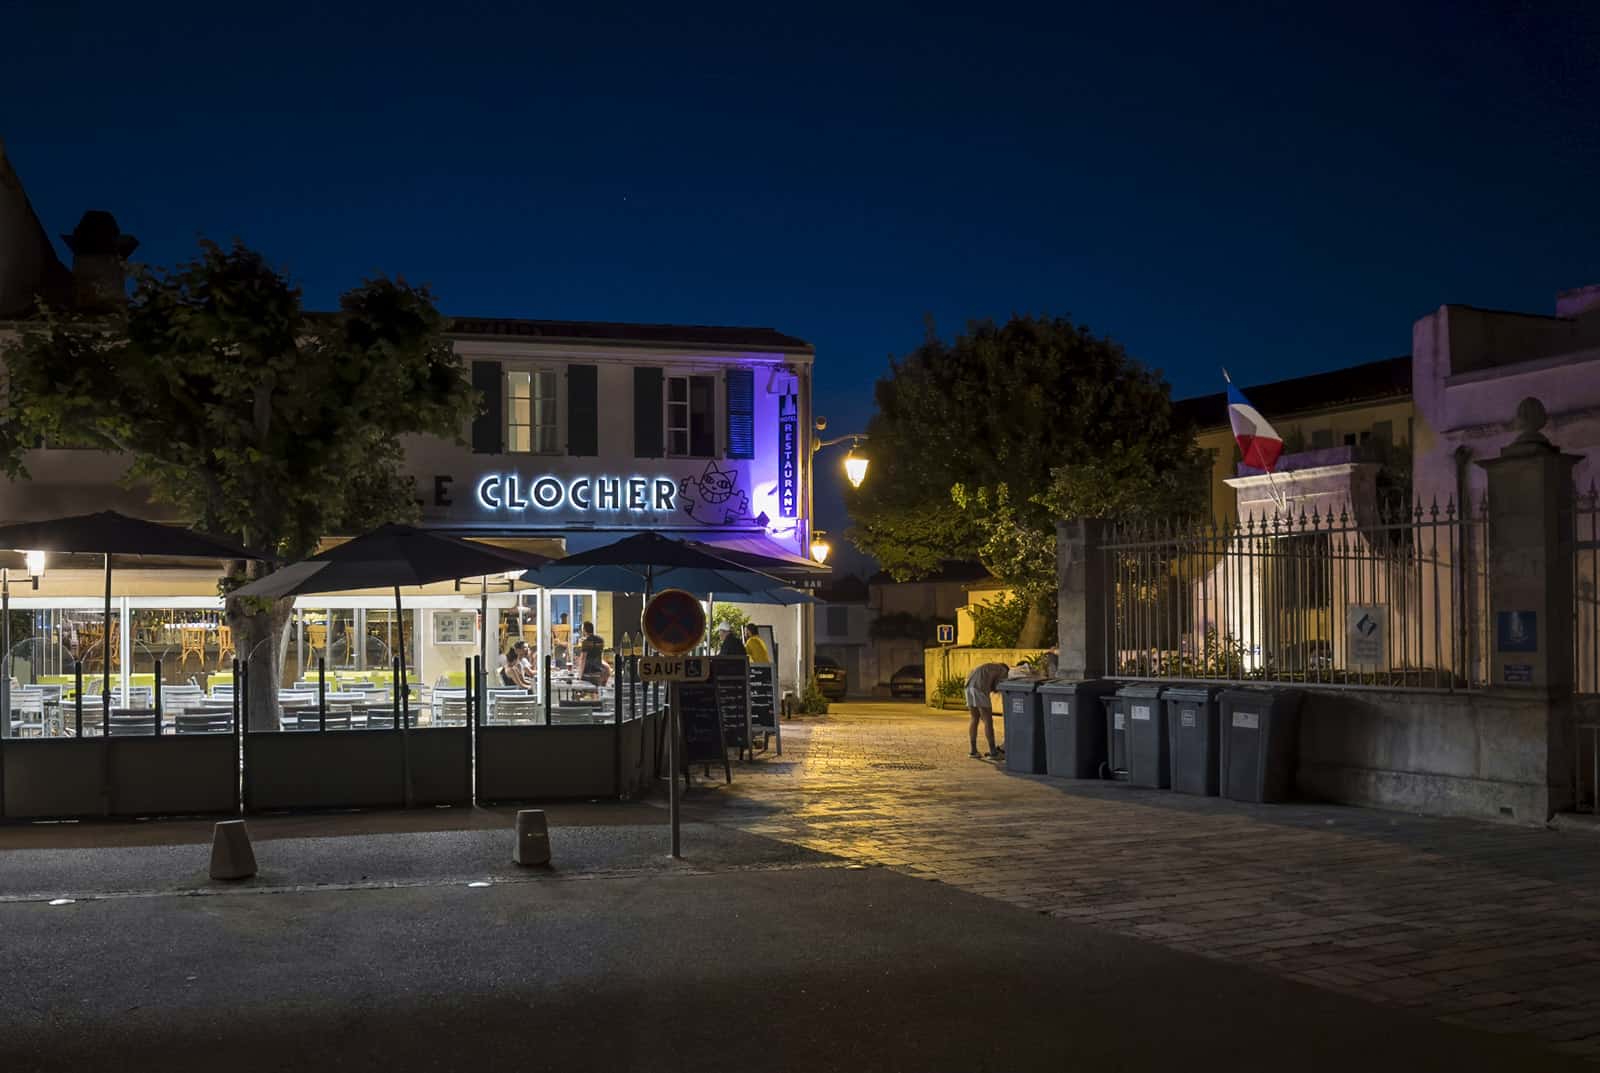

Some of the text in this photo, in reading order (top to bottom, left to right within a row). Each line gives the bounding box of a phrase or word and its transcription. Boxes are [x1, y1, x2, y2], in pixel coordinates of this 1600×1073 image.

[783, 424, 793, 517] RESTAURANT
[479, 475, 676, 511] CLOCHER
[643, 662, 681, 675] SAUF
